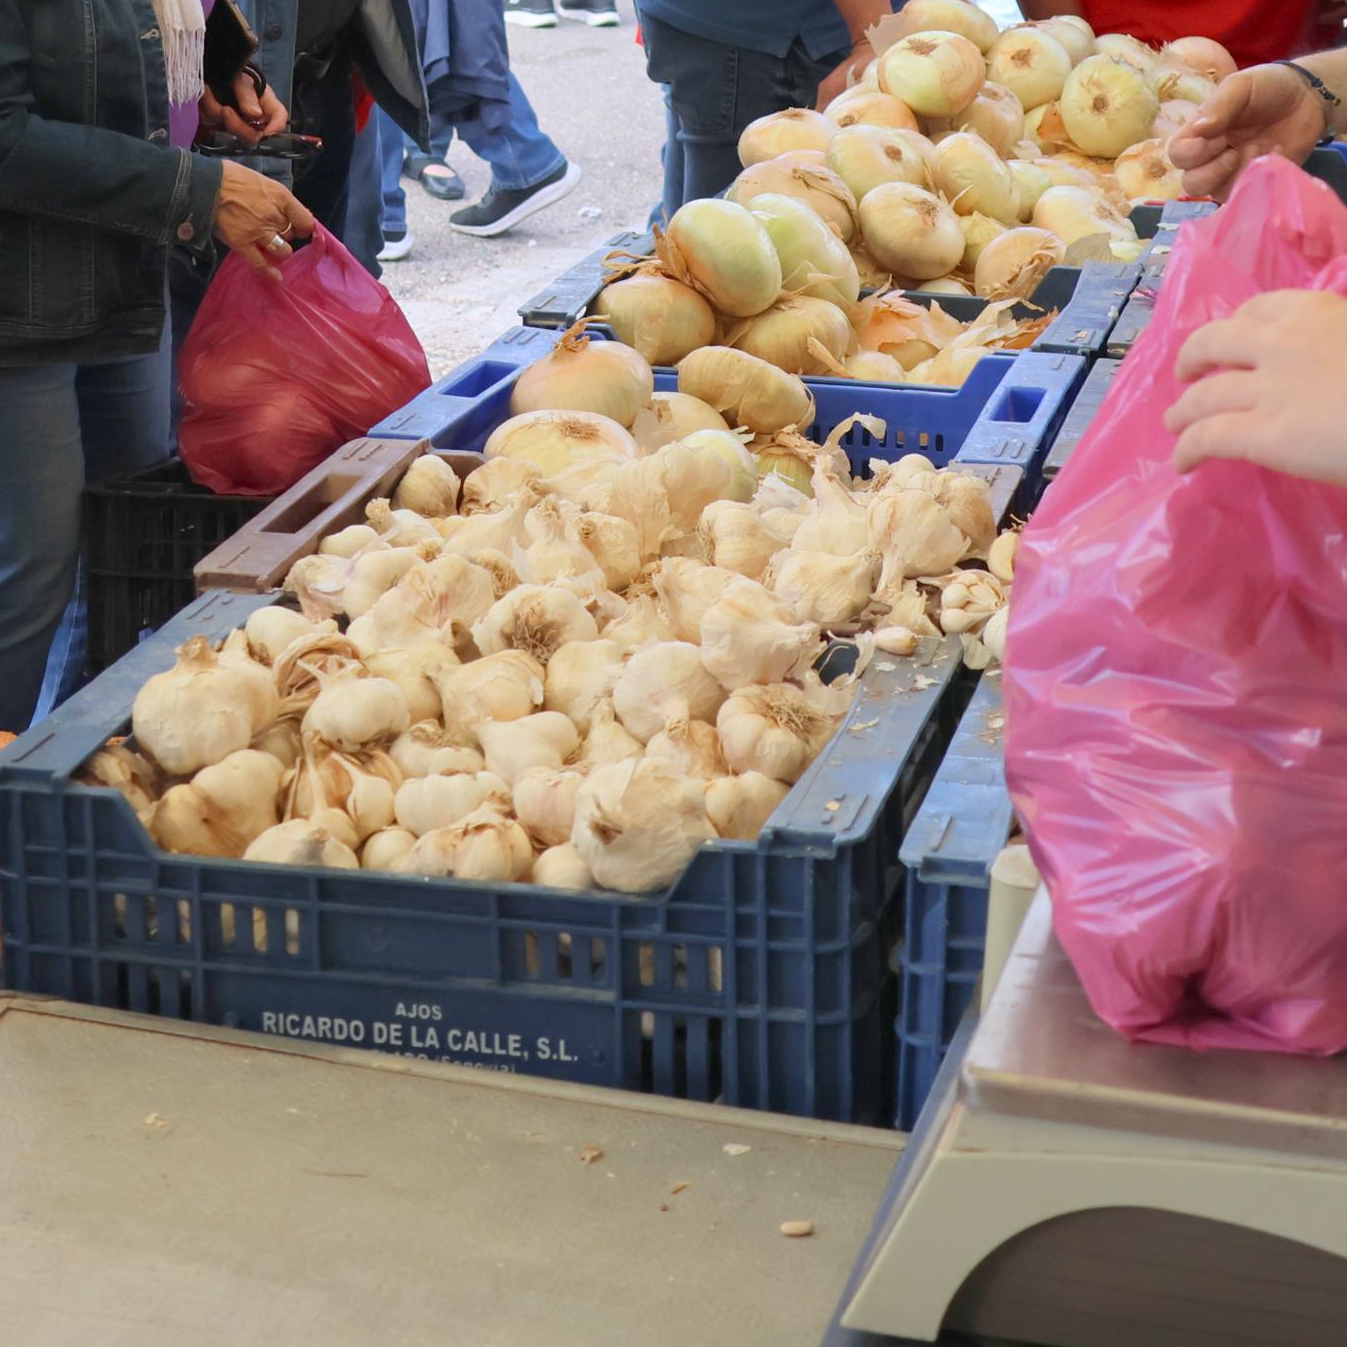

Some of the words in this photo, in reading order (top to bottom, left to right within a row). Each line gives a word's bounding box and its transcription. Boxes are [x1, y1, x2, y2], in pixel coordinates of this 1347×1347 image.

[394, 1001, 443, 1021] AJOS
[261, 1011, 365, 1042] RICARDO
[373, 1022, 403, 1047] DE
[410, 1026, 440, 1050] LA
[448, 1030, 529, 1060] CALLE,
[536, 1038, 579, 1062] S.L.
